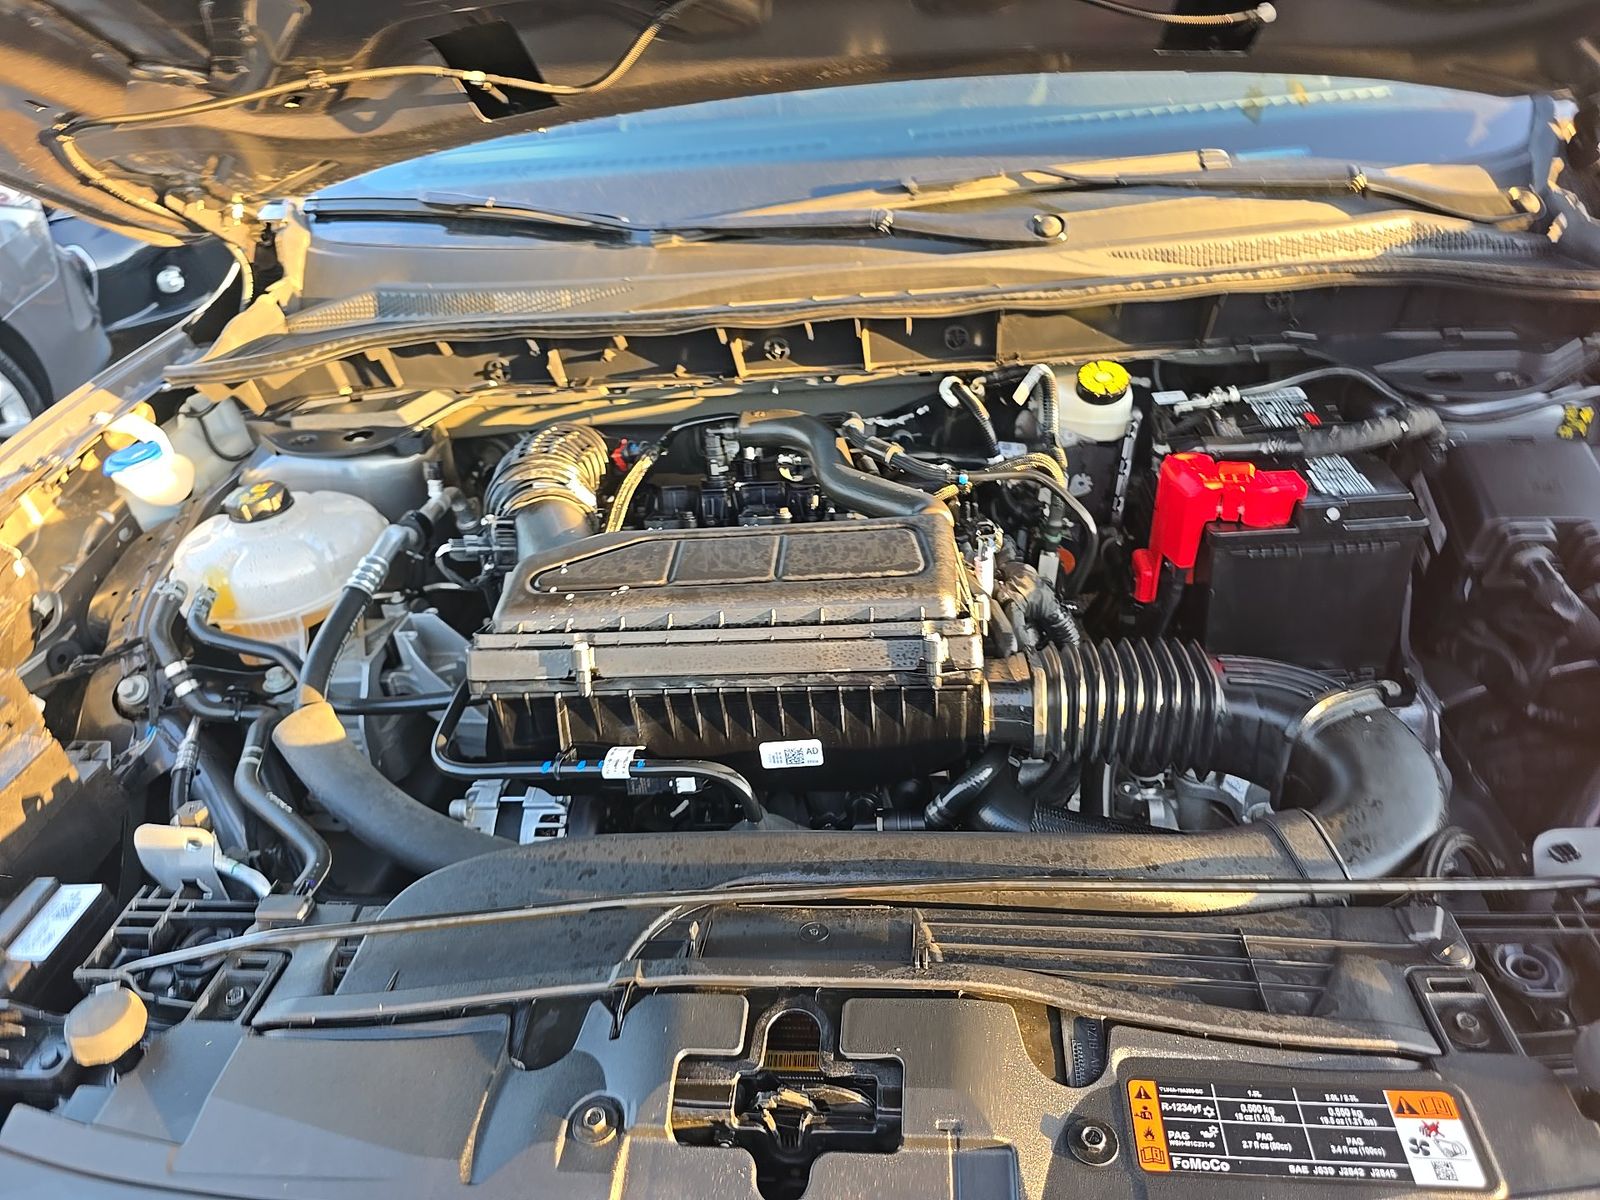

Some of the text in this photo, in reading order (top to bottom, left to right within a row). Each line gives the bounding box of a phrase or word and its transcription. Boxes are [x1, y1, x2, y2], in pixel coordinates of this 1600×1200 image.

[806, 747, 819, 755] AD
[1161, 1102, 1202, 1115] R-1234yf
[1240, 1103, 1276, 1116] 0.500 kg
[1350, 1108, 1364, 1119] kg
[1167, 1130, 1191, 1140] PAG
[1255, 1132, 1274, 1142] PAG
[1345, 1137, 1365, 1146] PAG
[1172, 1156, 1231, 1172] FoMoCo
[1288, 1164, 1310, 1175] SAE
